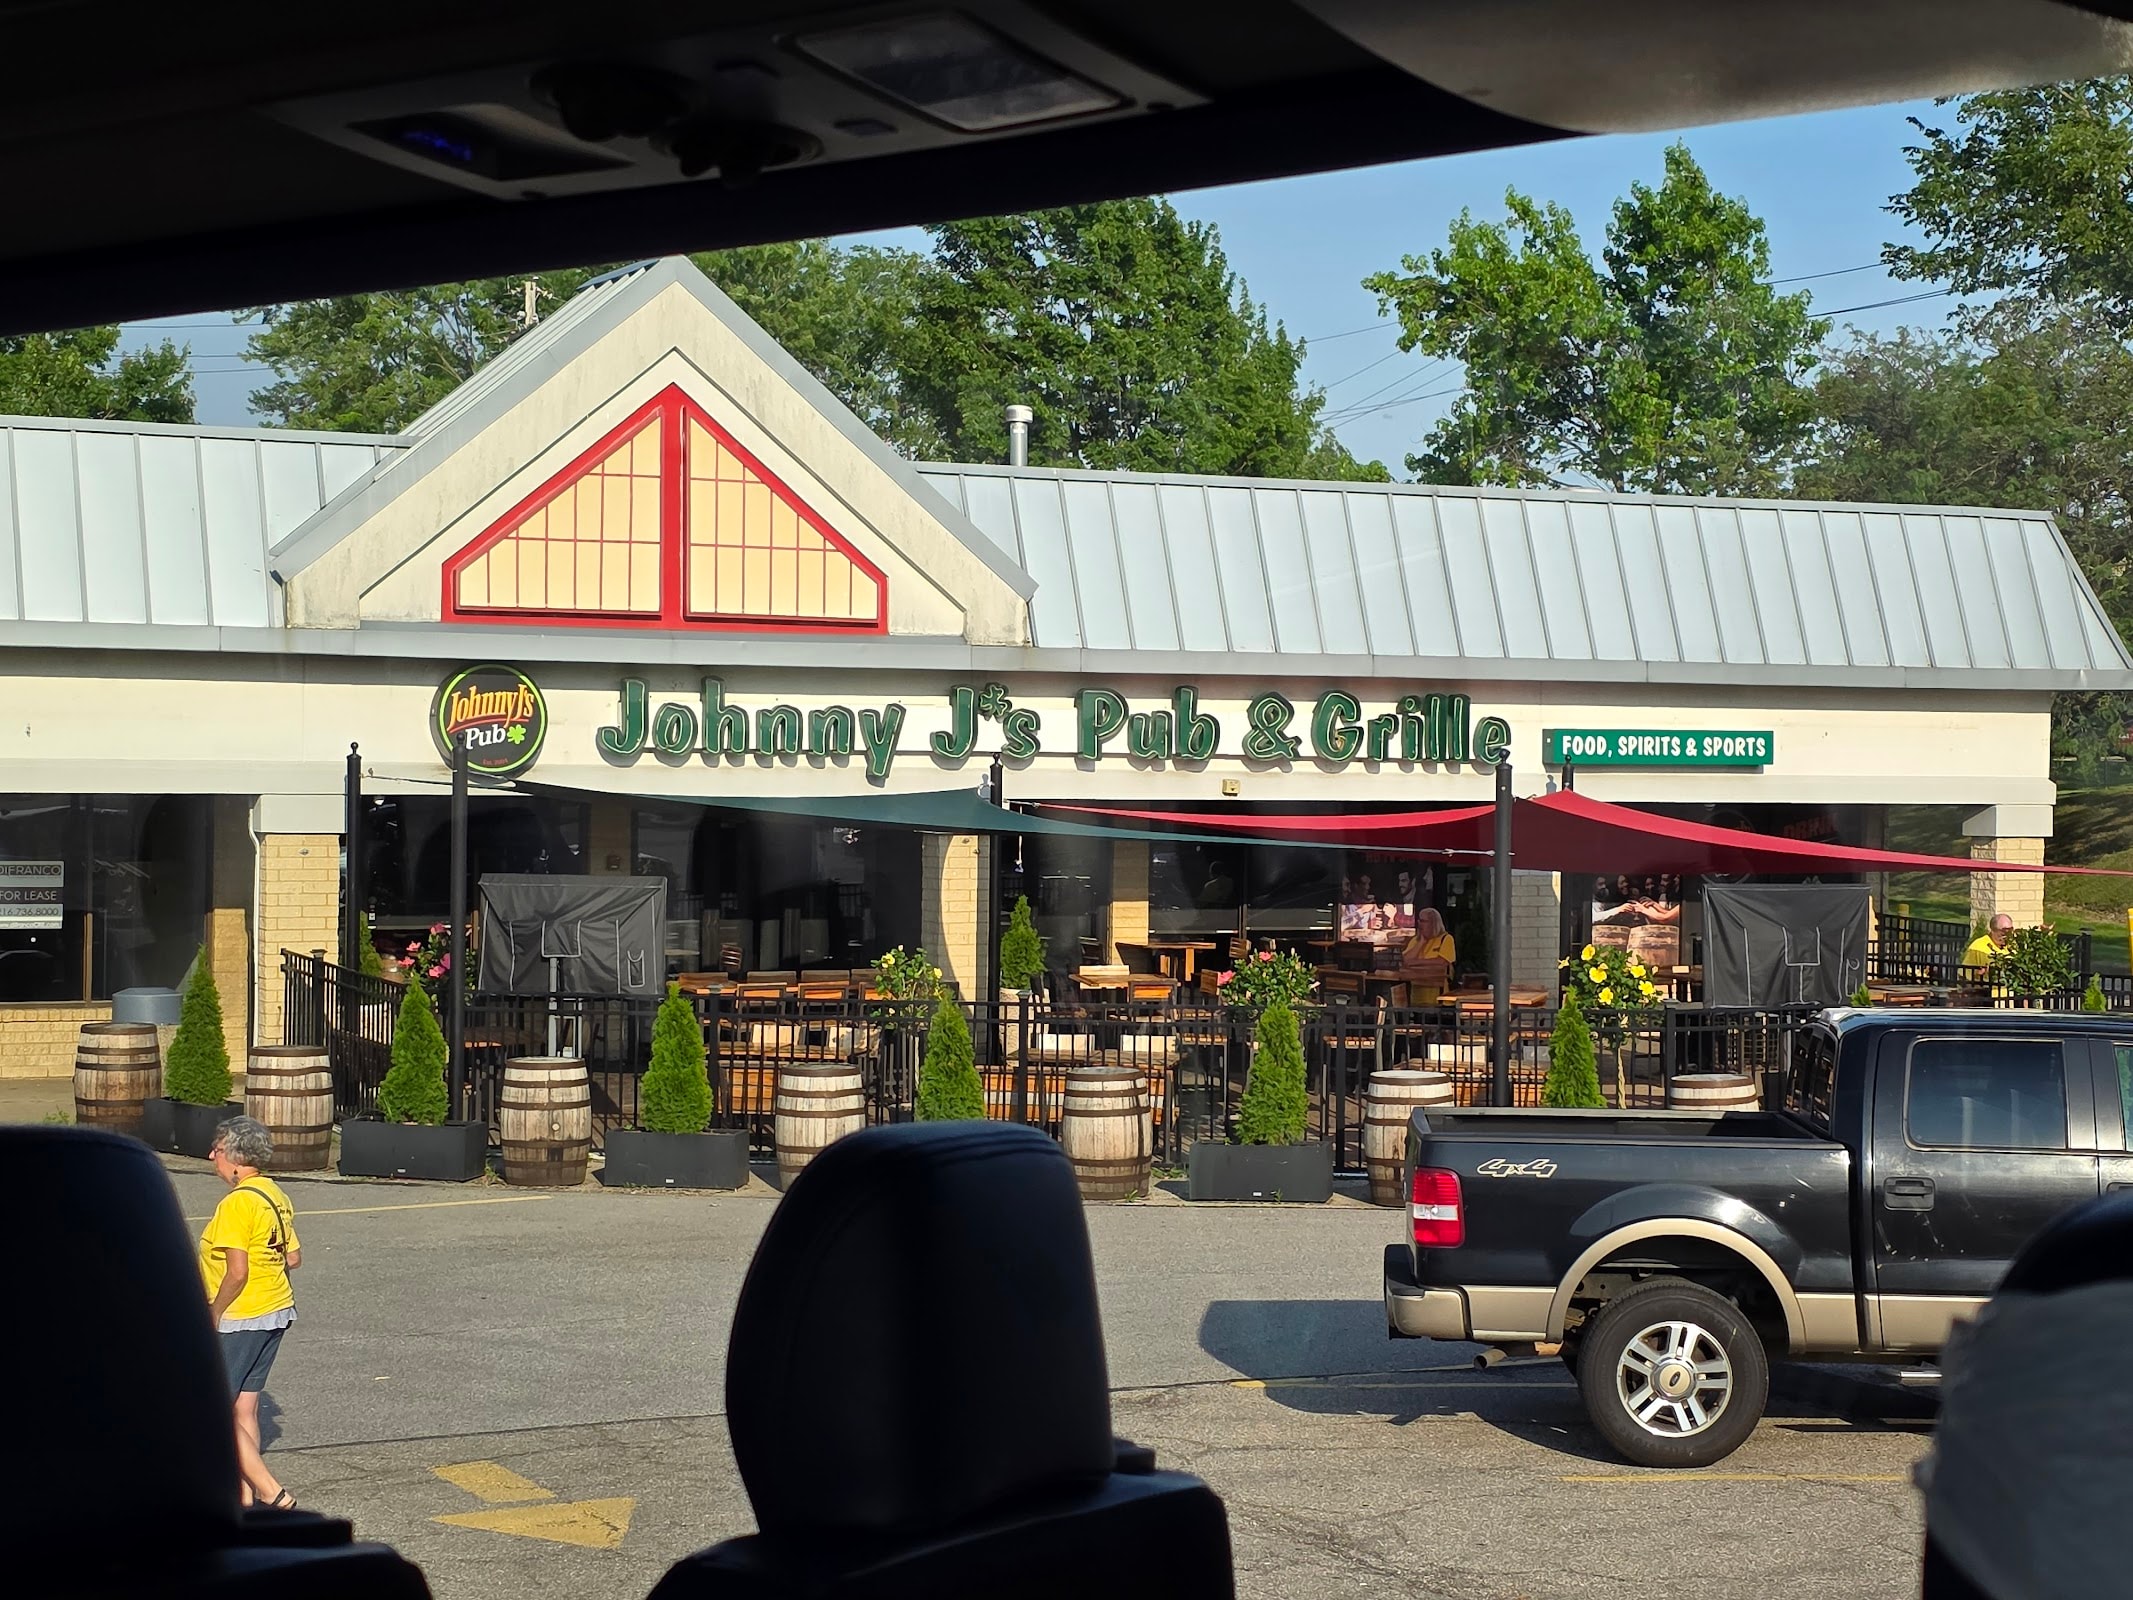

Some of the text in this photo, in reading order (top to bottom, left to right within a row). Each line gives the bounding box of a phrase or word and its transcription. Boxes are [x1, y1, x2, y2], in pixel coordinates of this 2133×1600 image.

[465, 724, 506, 750] Pub
[597, 677, 906, 779] Johnny
[1074, 685, 1220, 761] Pub
[1242, 691, 1302, 761] &
[1311, 690, 1511, 765] Grille
[1562, 735, 1766, 757] FOOD, SPIRITS & SPORTS
[0, 890, 57, 901] FOR LEASE
